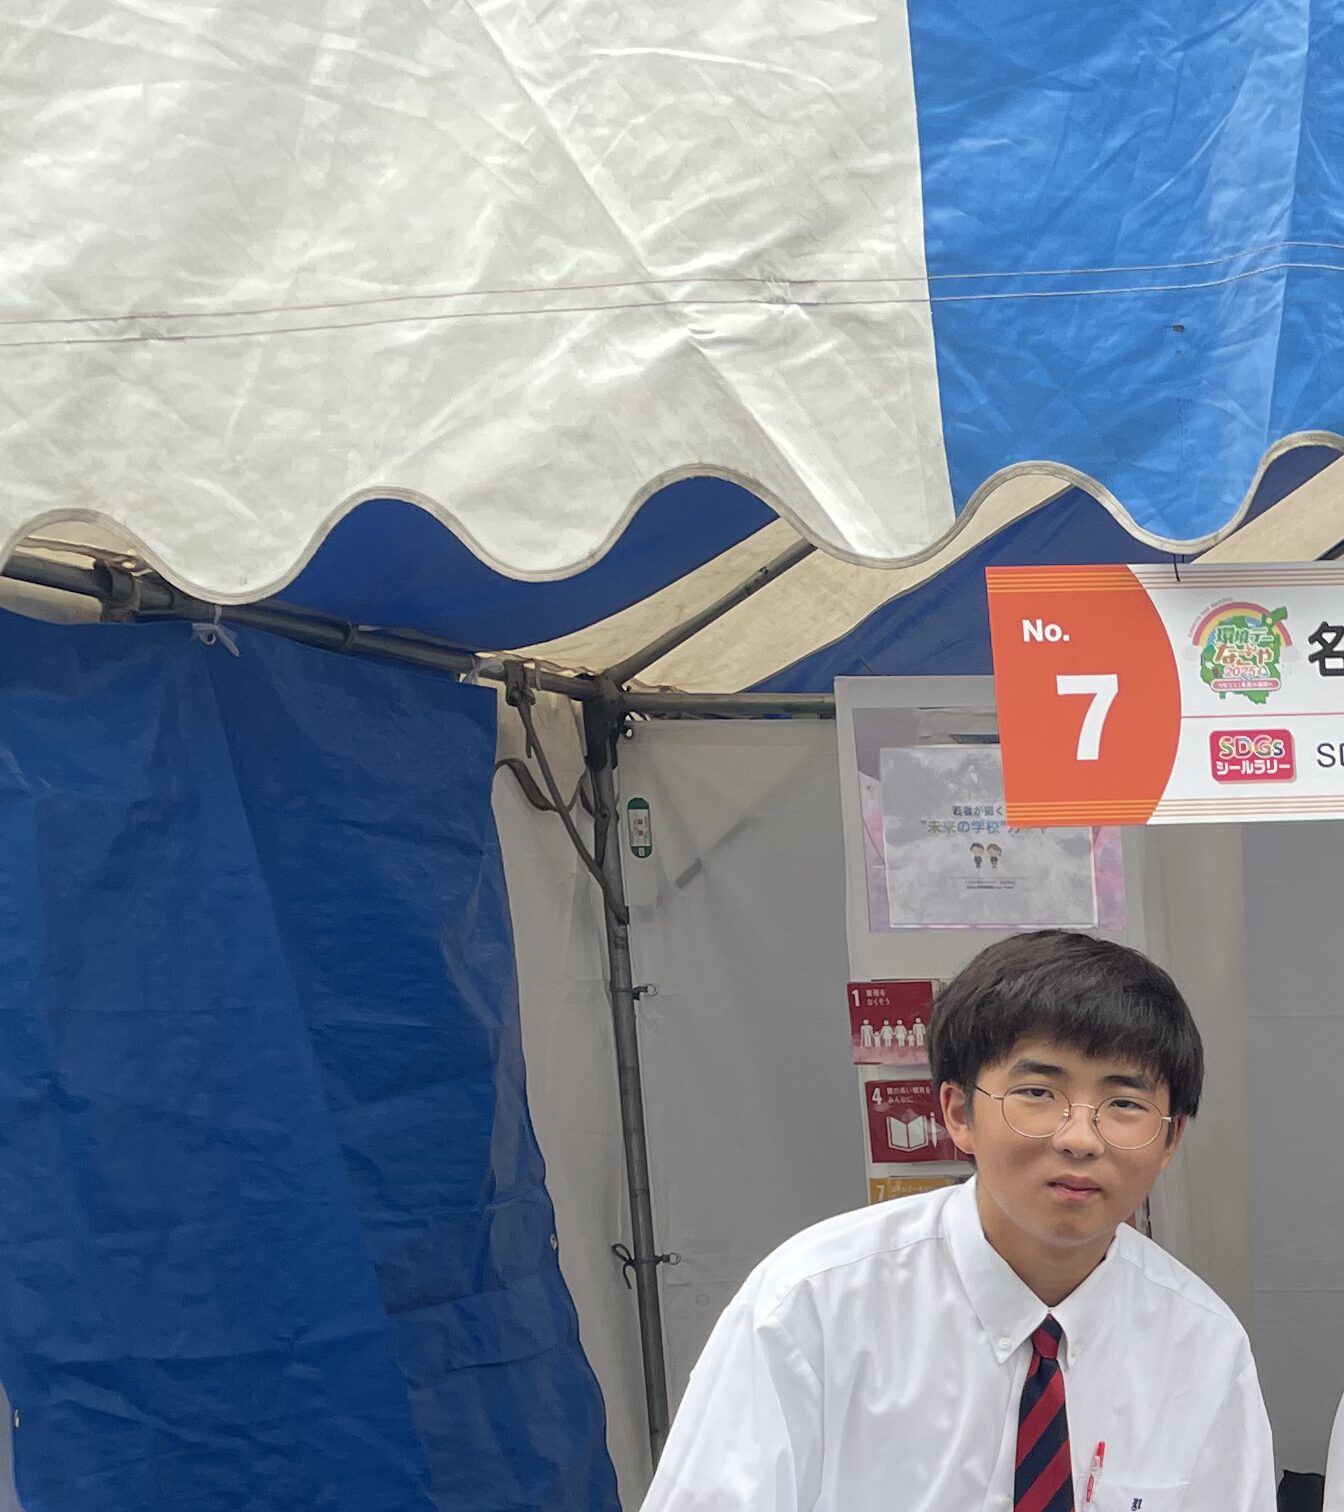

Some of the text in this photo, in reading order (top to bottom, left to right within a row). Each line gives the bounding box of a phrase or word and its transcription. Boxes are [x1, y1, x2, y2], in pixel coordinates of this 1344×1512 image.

[1021, 618, 1070, 643] No.
[1056, 674, 1119, 761] 7
[1219, 735, 1285, 759] SDGs
[1216, 759, 1291, 776] シールラリー
[851, 989, 860, 1007] 1
[872, 1087, 883, 1105] 4
